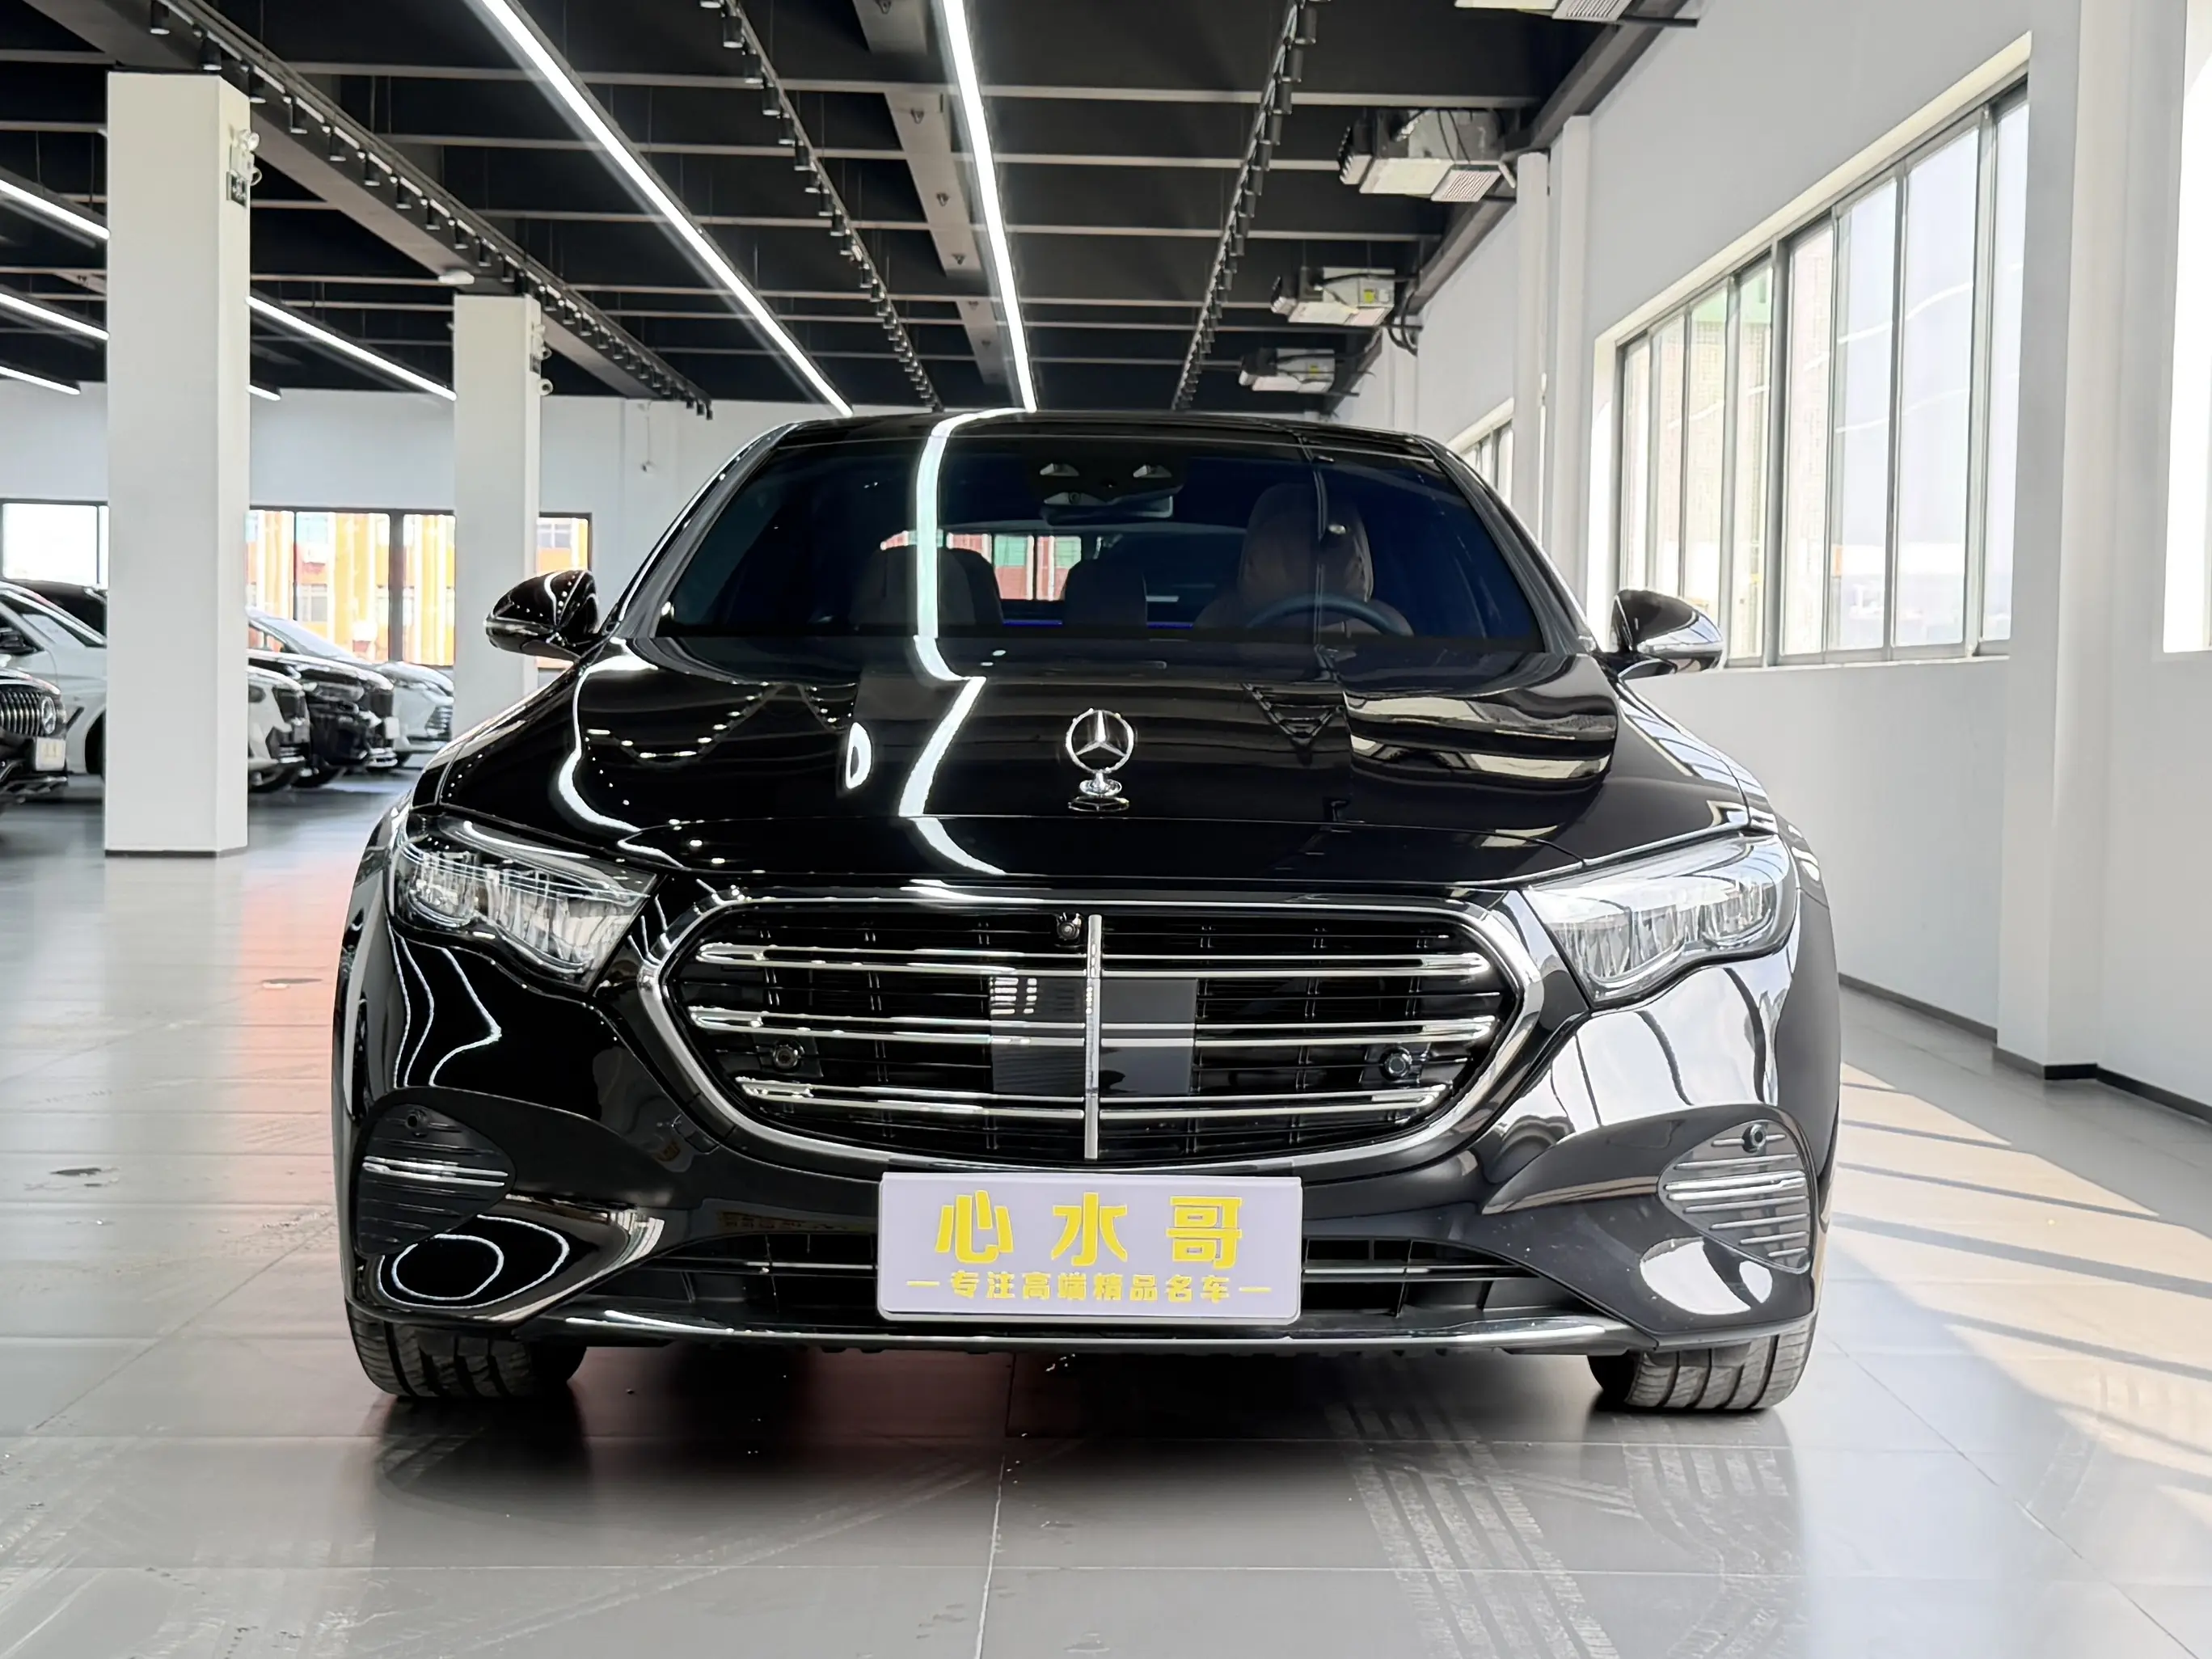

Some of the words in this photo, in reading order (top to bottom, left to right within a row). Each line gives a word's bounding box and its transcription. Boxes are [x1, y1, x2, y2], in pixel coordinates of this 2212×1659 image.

[935, 1189, 1243, 1269] 心水哥
[951, 1270, 1229, 1303] 专注高端精品名车
